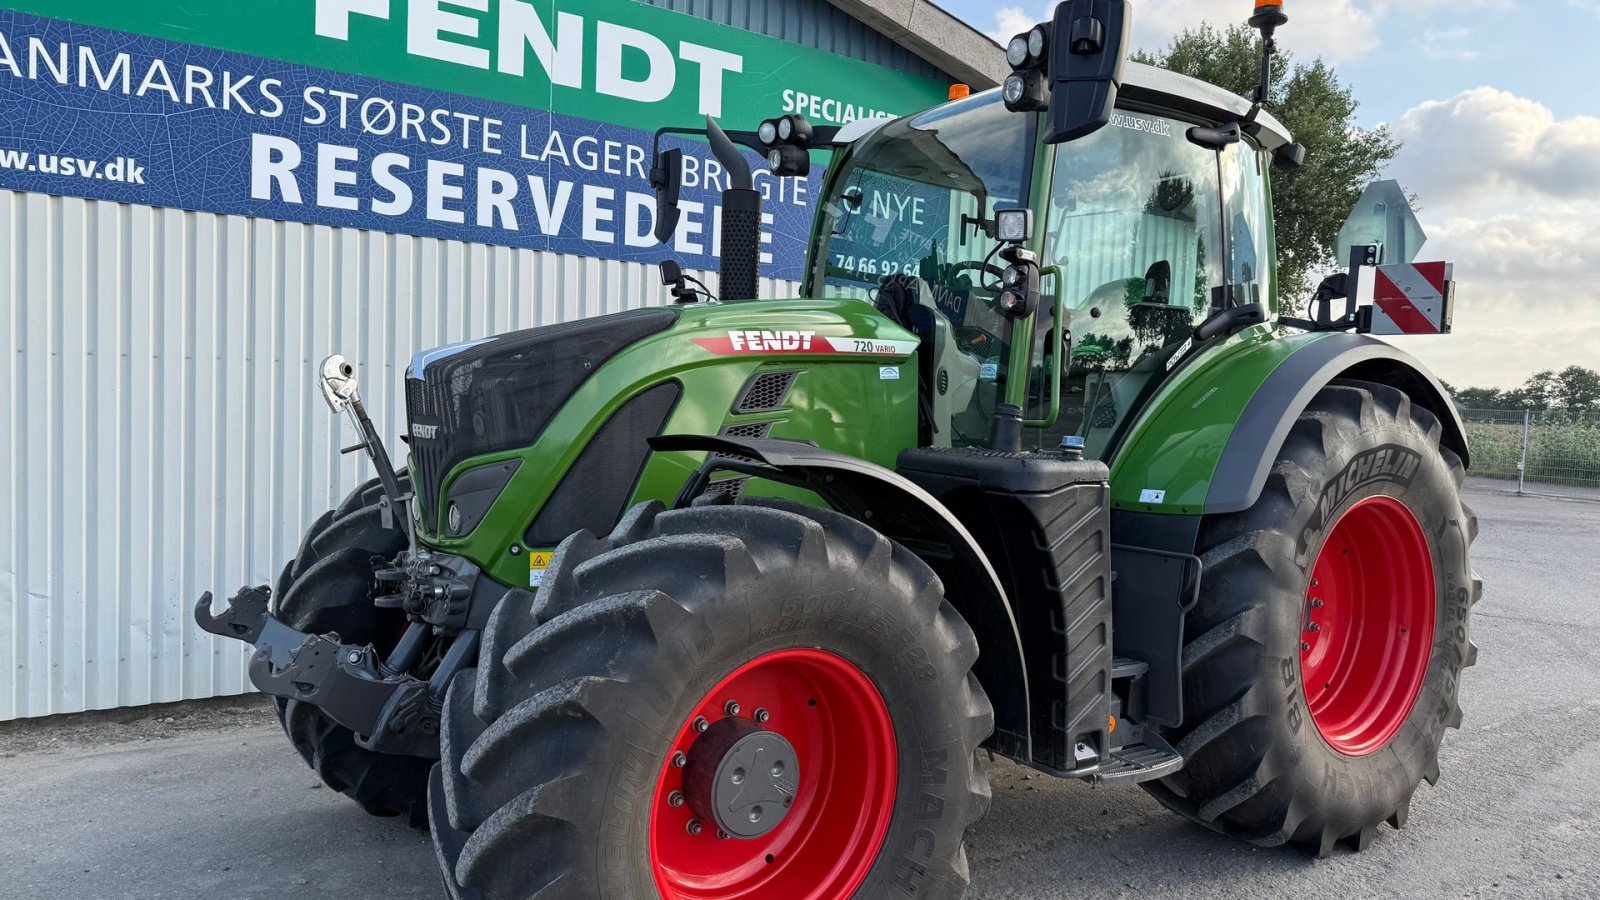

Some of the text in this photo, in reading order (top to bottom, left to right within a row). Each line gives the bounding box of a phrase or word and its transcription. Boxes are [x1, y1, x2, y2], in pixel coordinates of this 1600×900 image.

[303, 86, 502, 155] STØRSTE
[520, 124, 646, 180] LAGER
[681, 155, 807, 206] BRGTE
[872, 190, 925, 225] NYE
[836, 254, 854, 271] 74
[858, 257, 877, 274] 66
[881, 260, 899, 276] 92
[728, 330, 815, 351] FENDT
[853, 341, 896, 353] 720 VARIO
[412, 423, 438, 439] FENDT
[1319, 447, 1421, 528] MICHELIN
